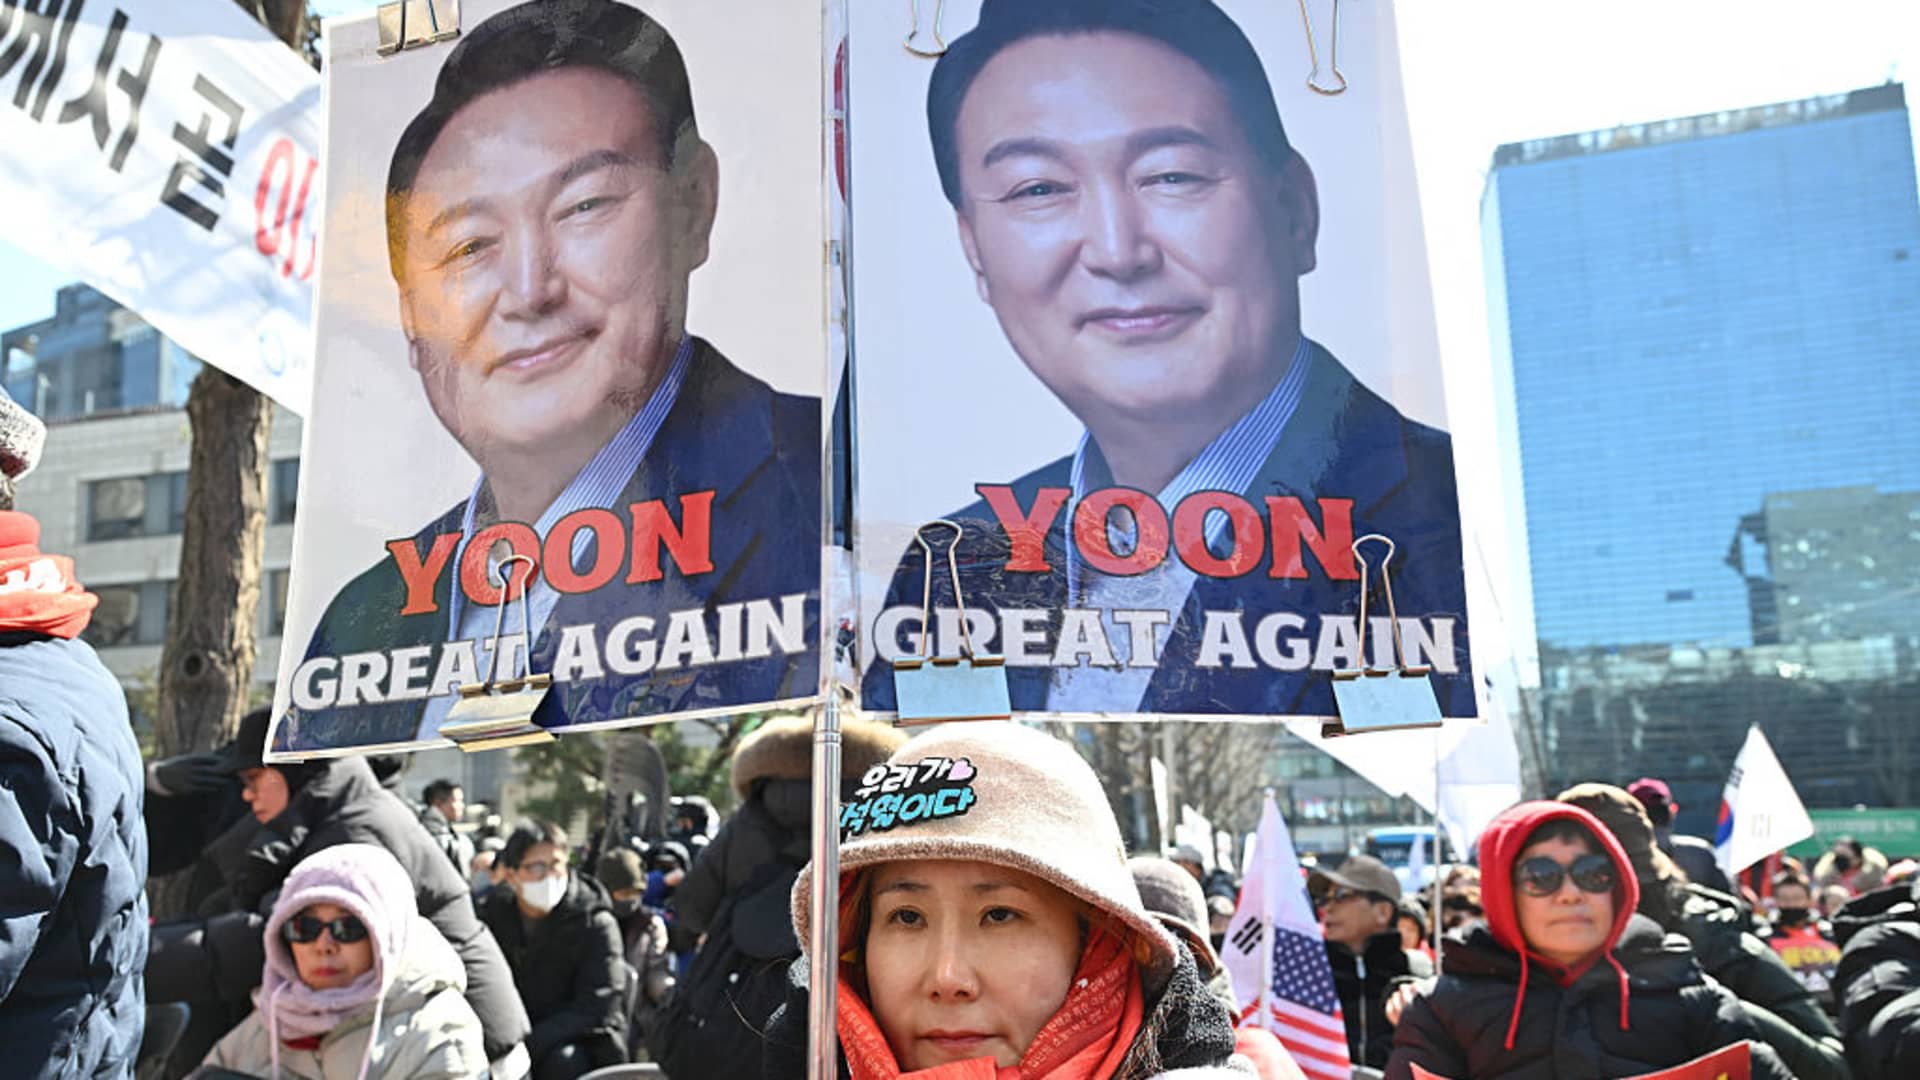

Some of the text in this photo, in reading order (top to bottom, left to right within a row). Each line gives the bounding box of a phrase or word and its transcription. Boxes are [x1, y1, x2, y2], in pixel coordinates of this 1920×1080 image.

[386, 490, 717, 615] YOON
[975, 484, 1359, 580] YOON
[291, 593, 808, 710] GREAT AGAIN
[872, 607, 1458, 673] GREAT AGAIN
[839, 787, 974, 832] 석열이다
